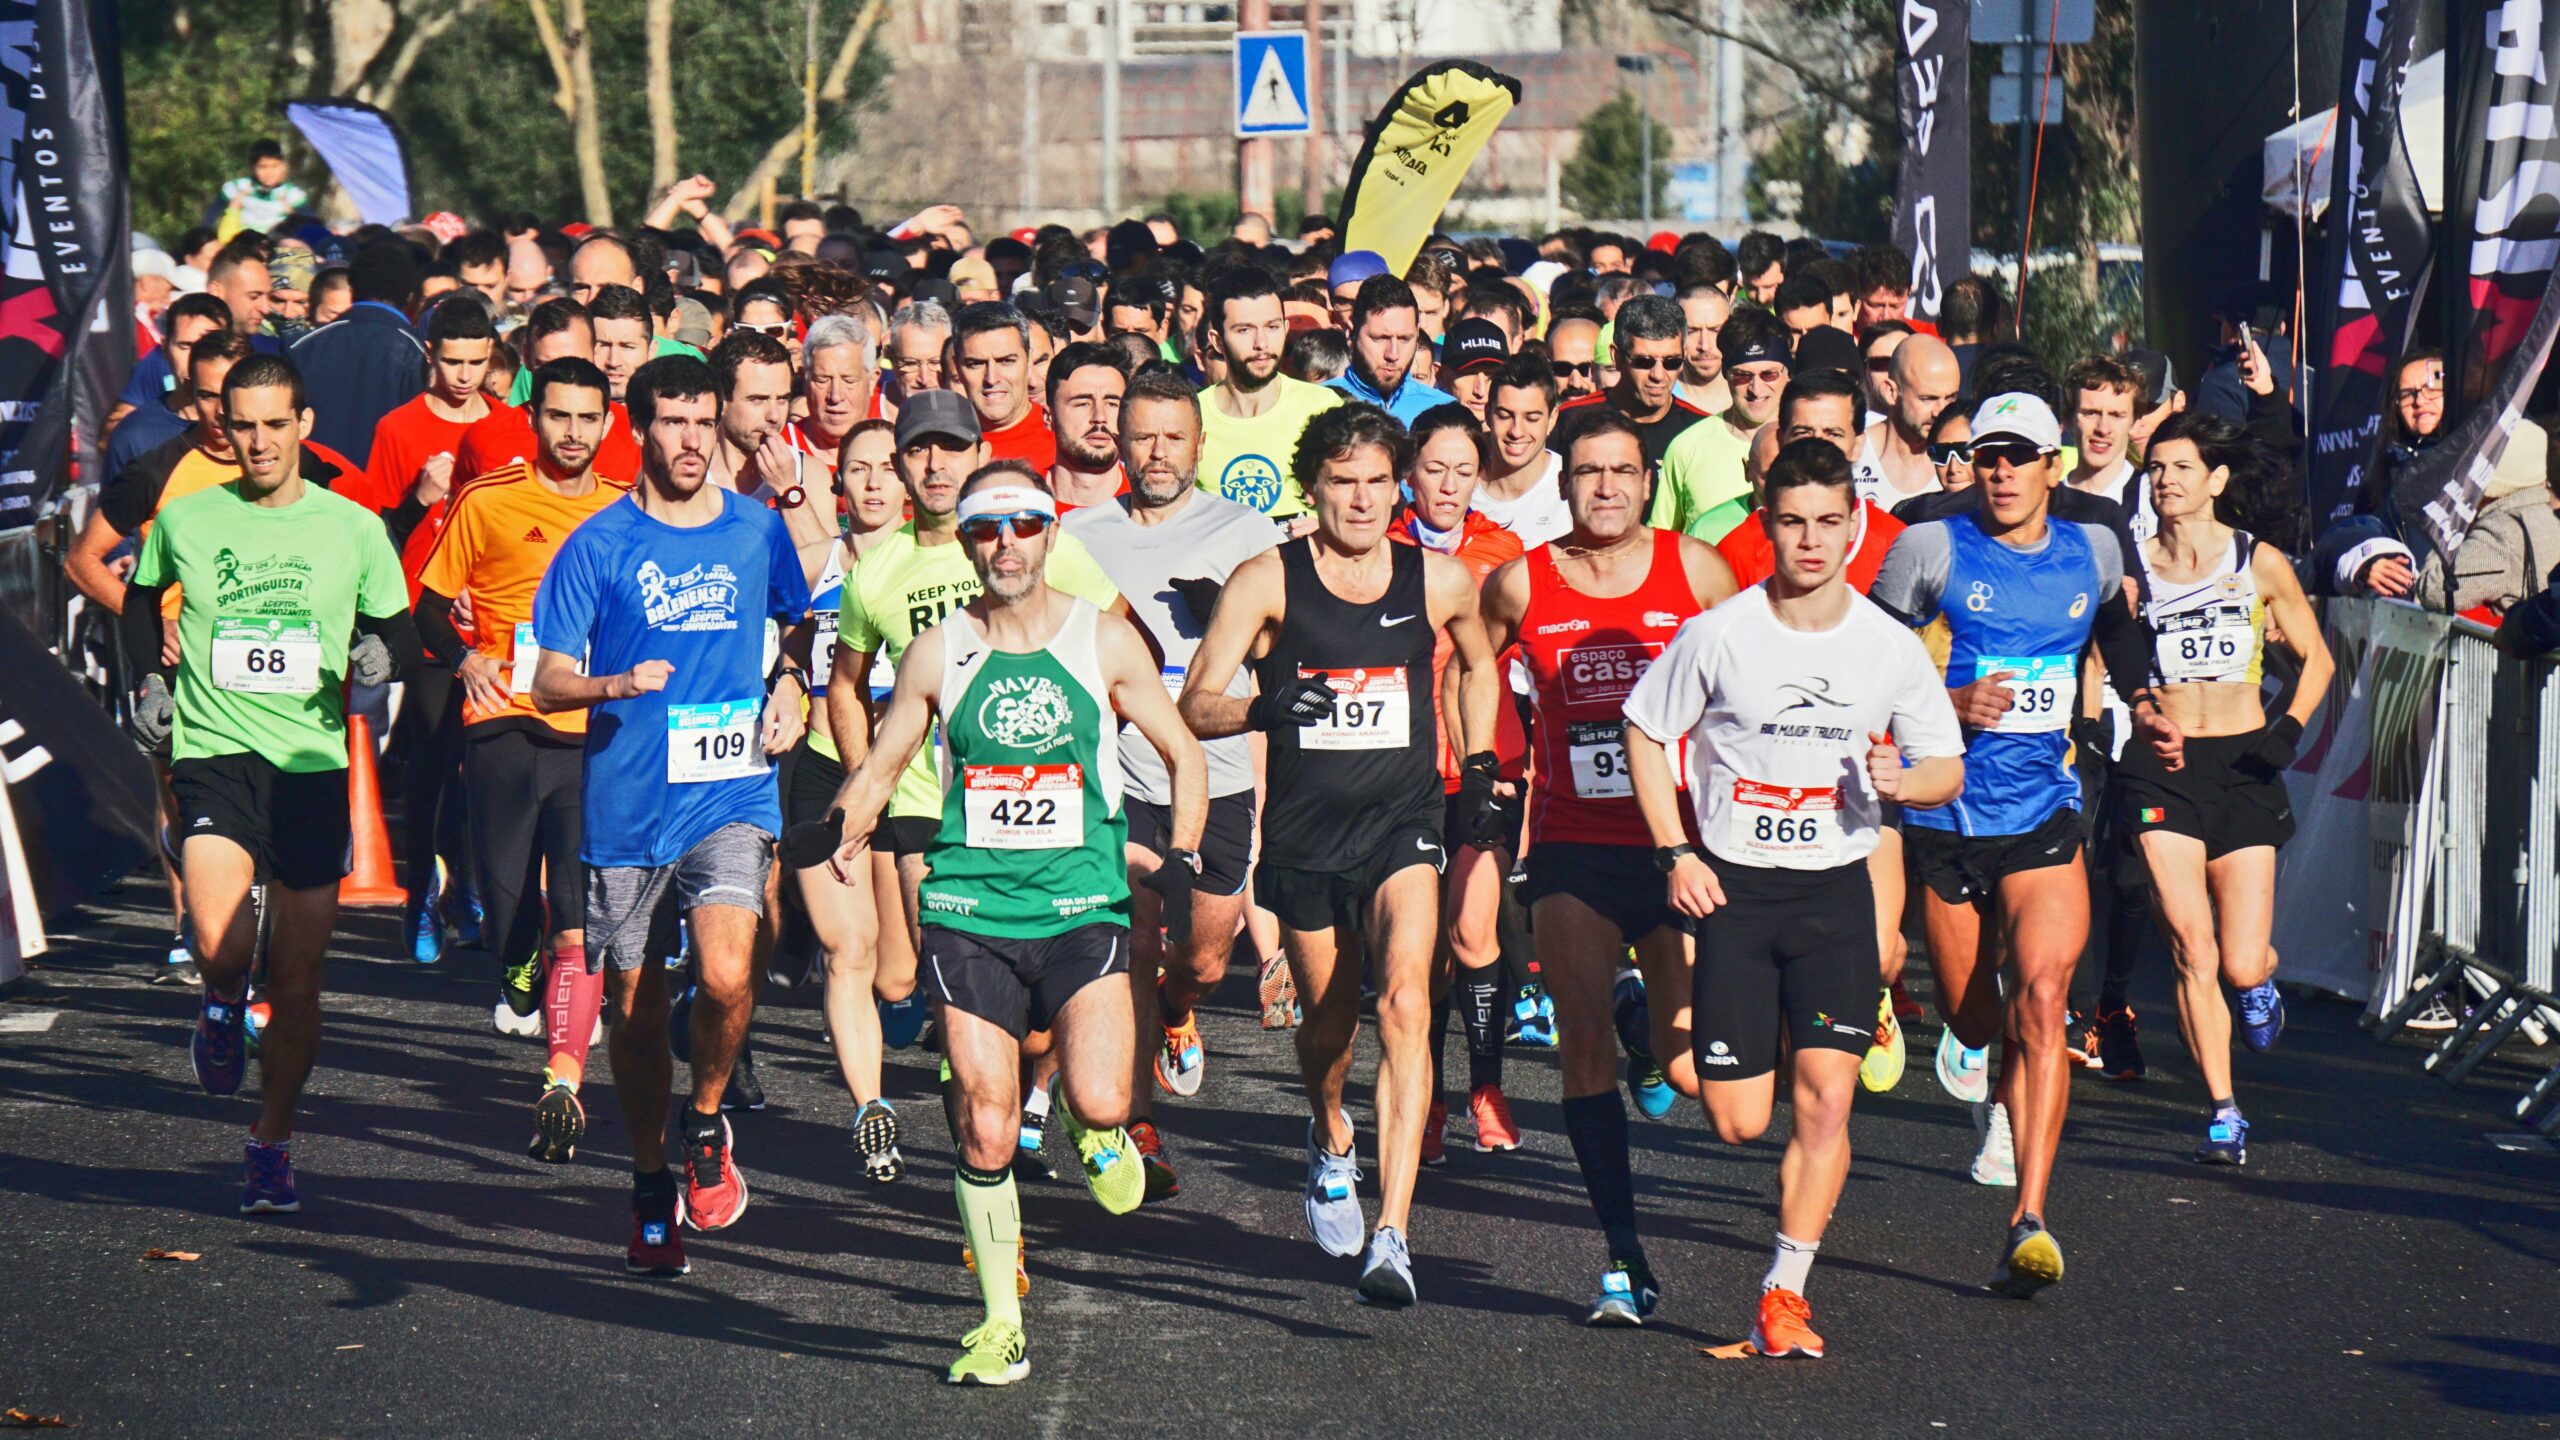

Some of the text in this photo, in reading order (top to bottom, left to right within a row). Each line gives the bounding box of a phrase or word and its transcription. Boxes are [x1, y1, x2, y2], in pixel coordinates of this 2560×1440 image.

[31, 127, 87, 274] EVENTOS
[1461, 338, 1501, 350] HUUB
[216, 578, 303, 608] SPORTINGUISTA
[262, 600, 298, 608] ADEPTOS
[645, 586, 727, 625] BELENENSE
[907, 585, 946, 604] KEEP
[254, 607, 312, 617] SIMPATIZANTES
[1537, 619, 1590, 635] macron
[1571, 649, 1626, 665] espaço
[2181, 633, 2235, 660] 876
[247, 648, 286, 674] 68
[1573, 658, 1652, 683] casa
[2002, 687, 2055, 713] 39
[694, 732, 745, 761] 109
[1034, 733, 1075, 756] VILA REAL
[1580, 730, 1620, 743] FAIR PLAY
[990, 798, 1056, 826] 422
[995, 828, 1053, 836] JORGE VILELA
[1755, 815, 1817, 843] 866
